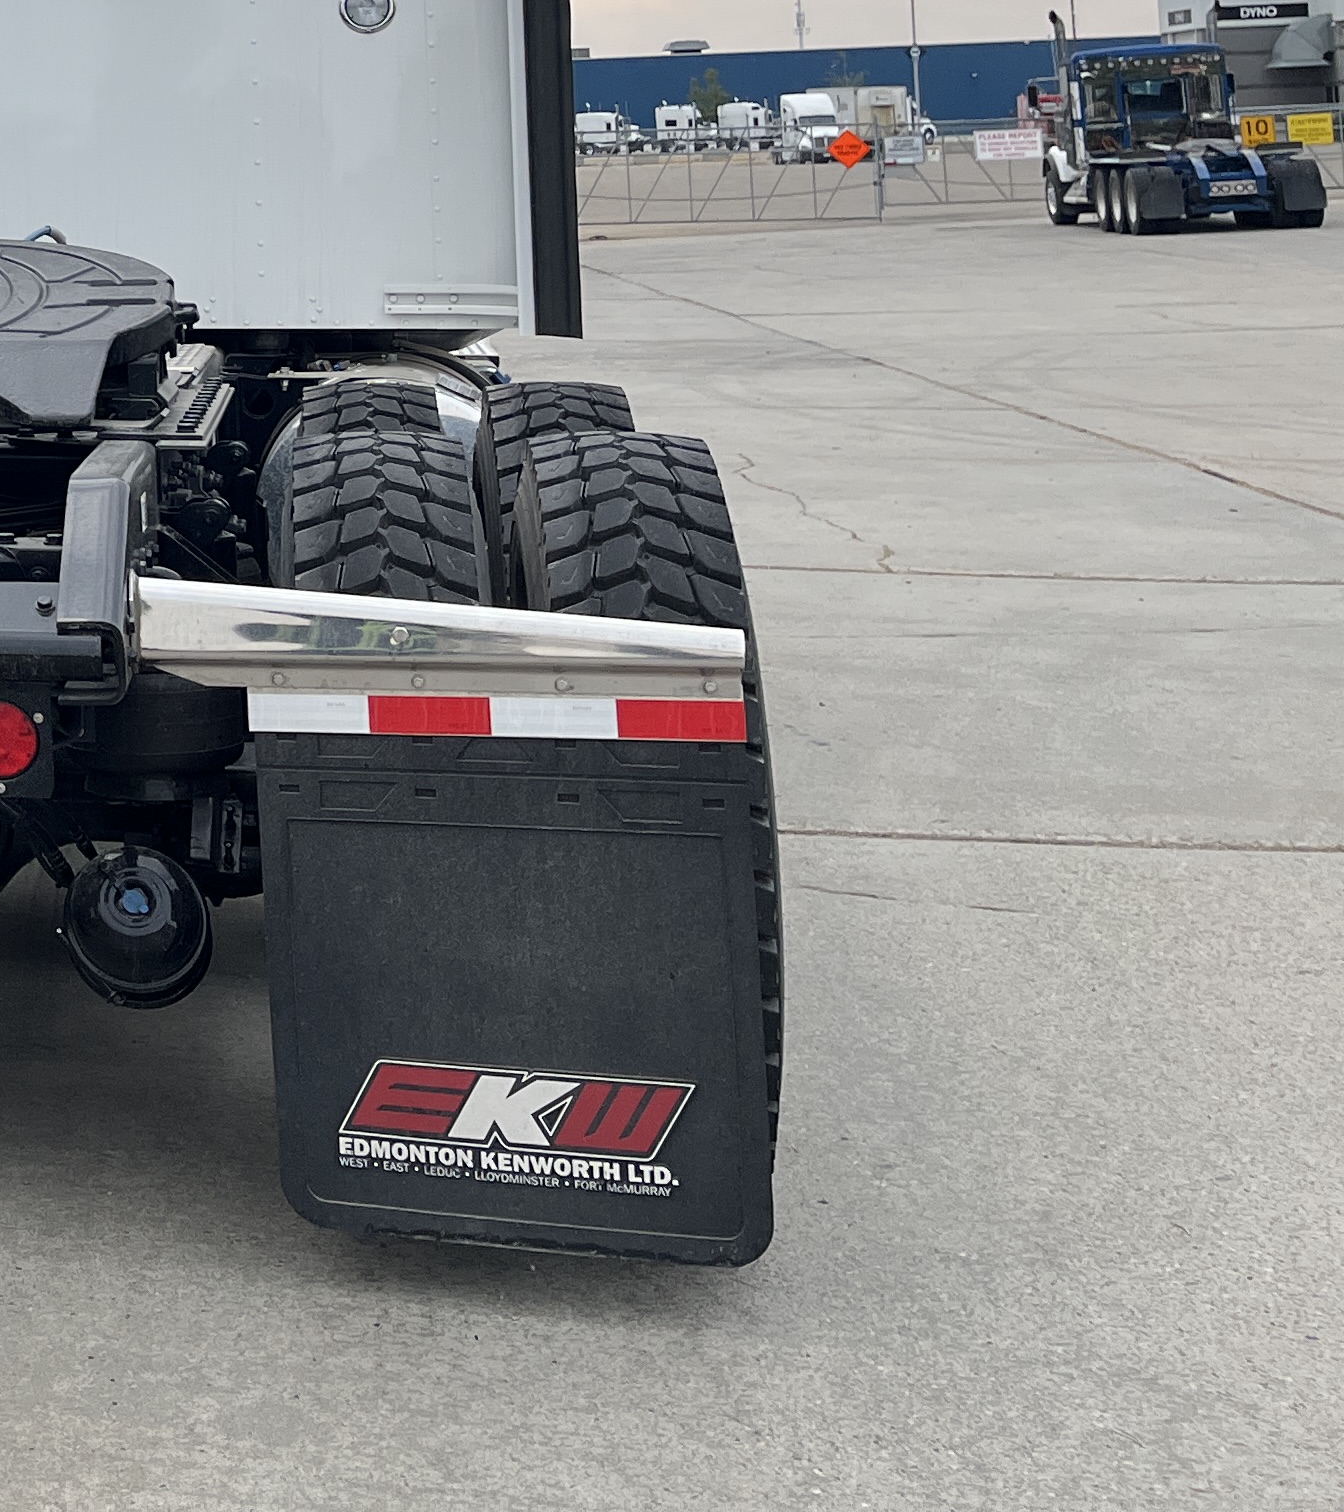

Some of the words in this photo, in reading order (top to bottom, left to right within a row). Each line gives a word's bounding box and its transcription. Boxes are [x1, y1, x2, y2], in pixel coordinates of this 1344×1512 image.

[1240, 5, 1278, 19] DYNO
[1245, 119, 1269, 136] 10
[351, 1063, 686, 1154] EKW
[338, 1136, 474, 1168] EDMONTON
[480, 1150, 621, 1181] KENWORTH
[627, 1163, 680, 1186] LTD.
[338, 1156, 370, 1168] WEST
[383, 1161, 410, 1173] EAST
[423, 1165, 461, 1179] LEDUC
[474, 1170, 561, 1188] LLOYDMINSTER
[574, 1179, 604, 1191] FORT
[606, 1182, 672, 1197] McMURRAY
